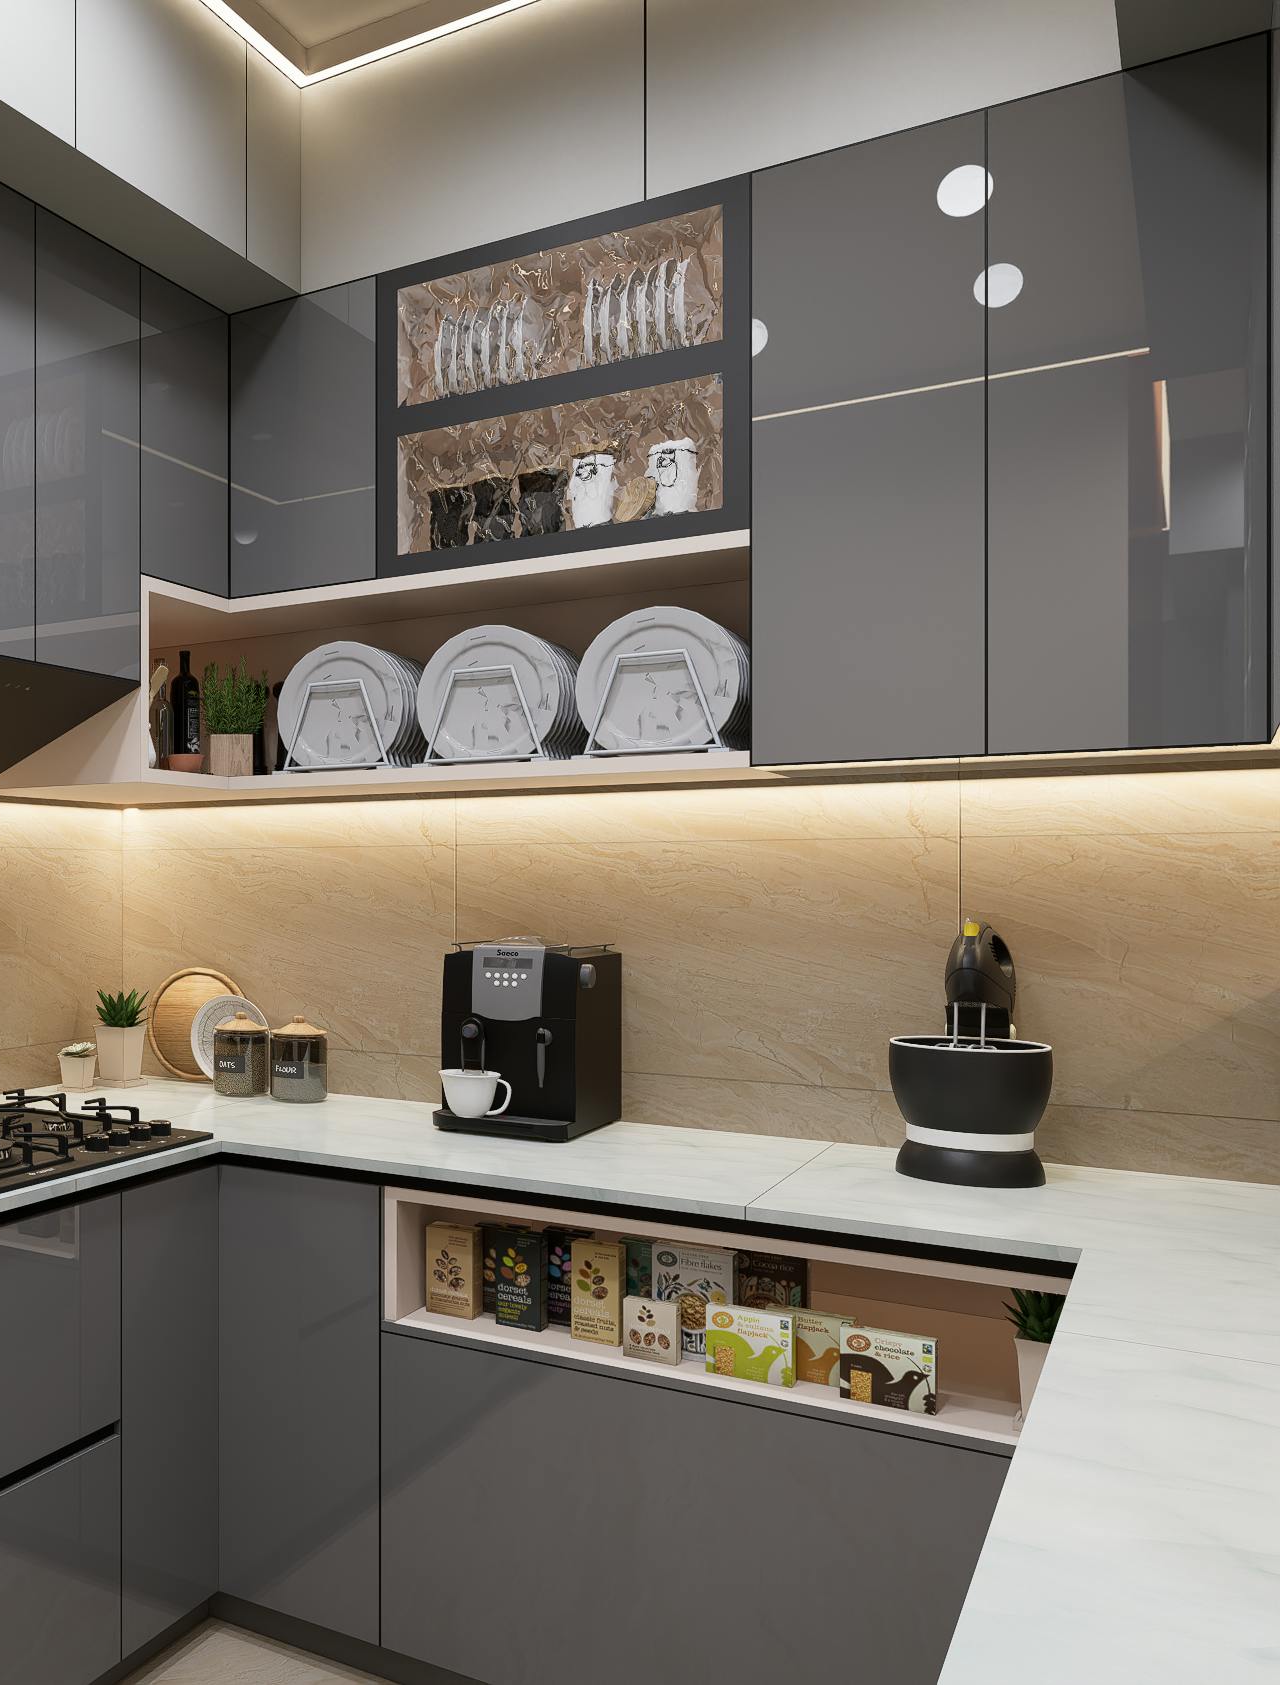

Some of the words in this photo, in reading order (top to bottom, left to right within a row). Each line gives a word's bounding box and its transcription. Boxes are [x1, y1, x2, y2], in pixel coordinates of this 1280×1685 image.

[496, 949, 519, 957] Saeco
[218, 1060, 236, 1069] OATS
[275, 1064, 297, 1074] FLOUR
[680, 1258, 699, 1267] Fibre
[700, 1260, 722, 1271] flakes
[497, 1283, 528, 1296] dorset
[497, 1293, 532, 1304] cereals
[797, 1316, 823, 1326] Butter
[737, 1328, 769, 1339] flapjack
[797, 1323, 830, 1334] flapjack
[874, 1337, 903, 1348] Crispy
[874, 1345, 916, 1356] chocolate
[883, 1353, 901, 1361] rice
